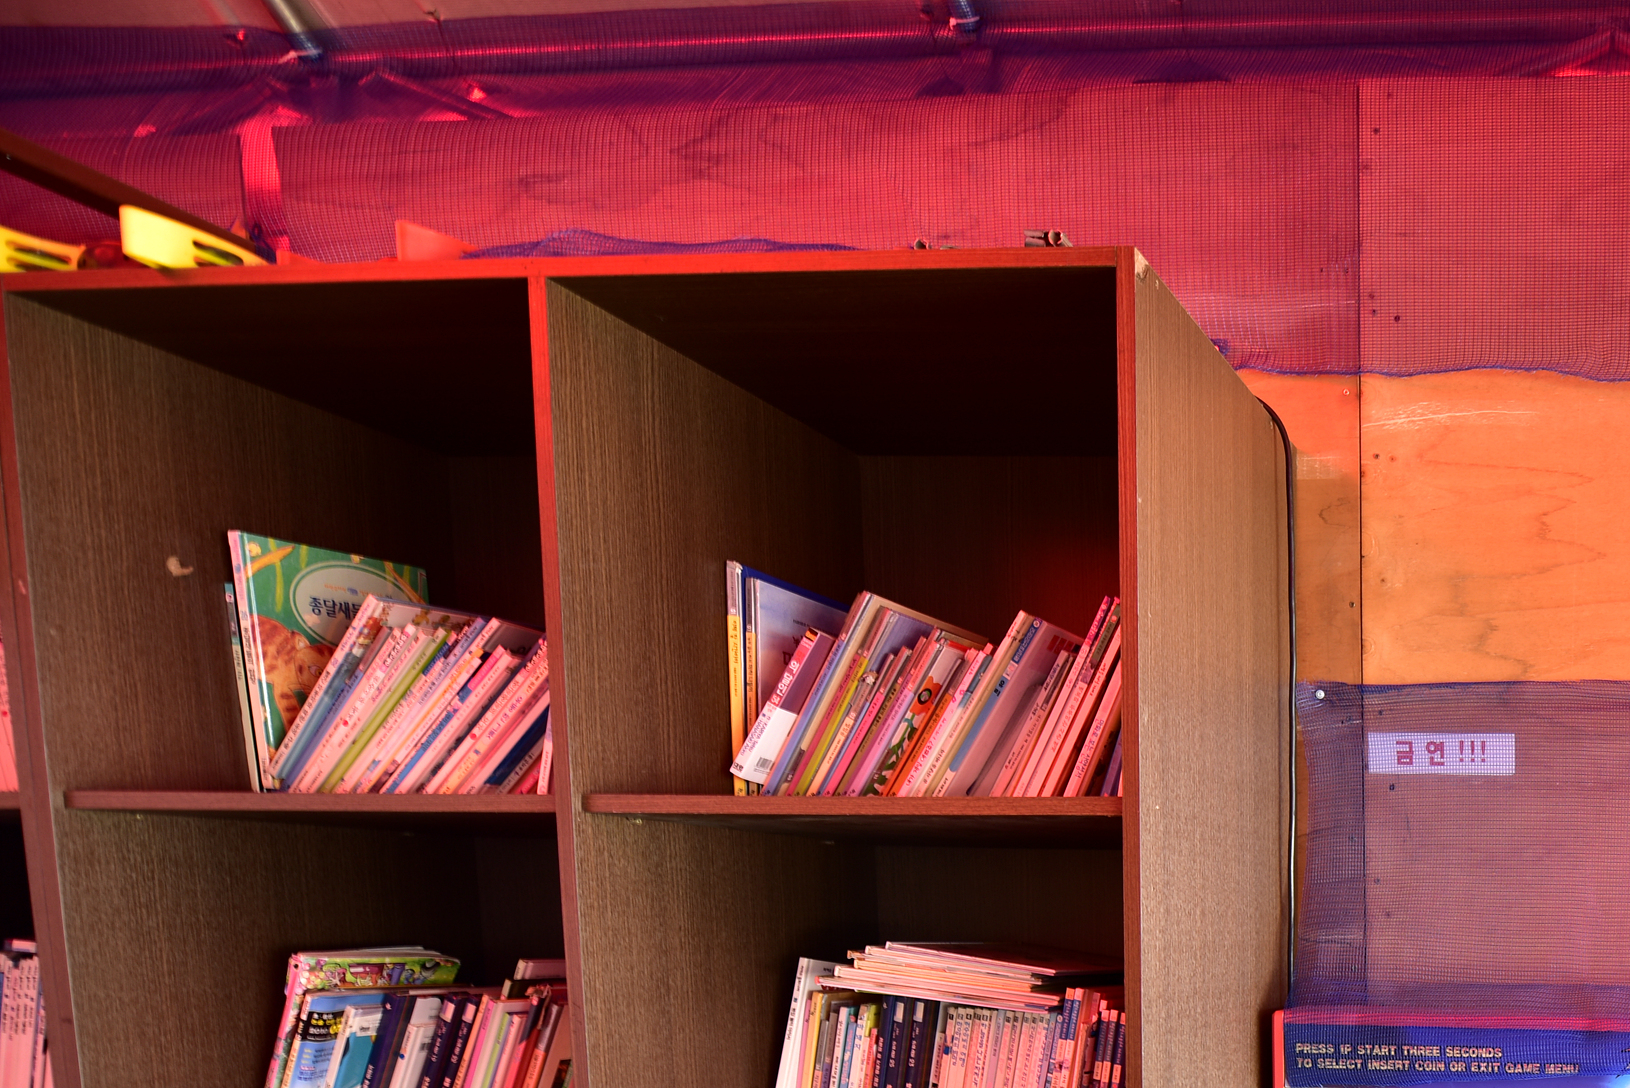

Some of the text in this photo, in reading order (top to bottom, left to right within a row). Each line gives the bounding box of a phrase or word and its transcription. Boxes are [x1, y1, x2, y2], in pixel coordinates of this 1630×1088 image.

[1295, 1043, 1502, 1059] PRESS 1P START THREE SECONDS
[1296, 1058, 1579, 1074] TO SELECT INSERT COIN OR EXIT GAME MENU
